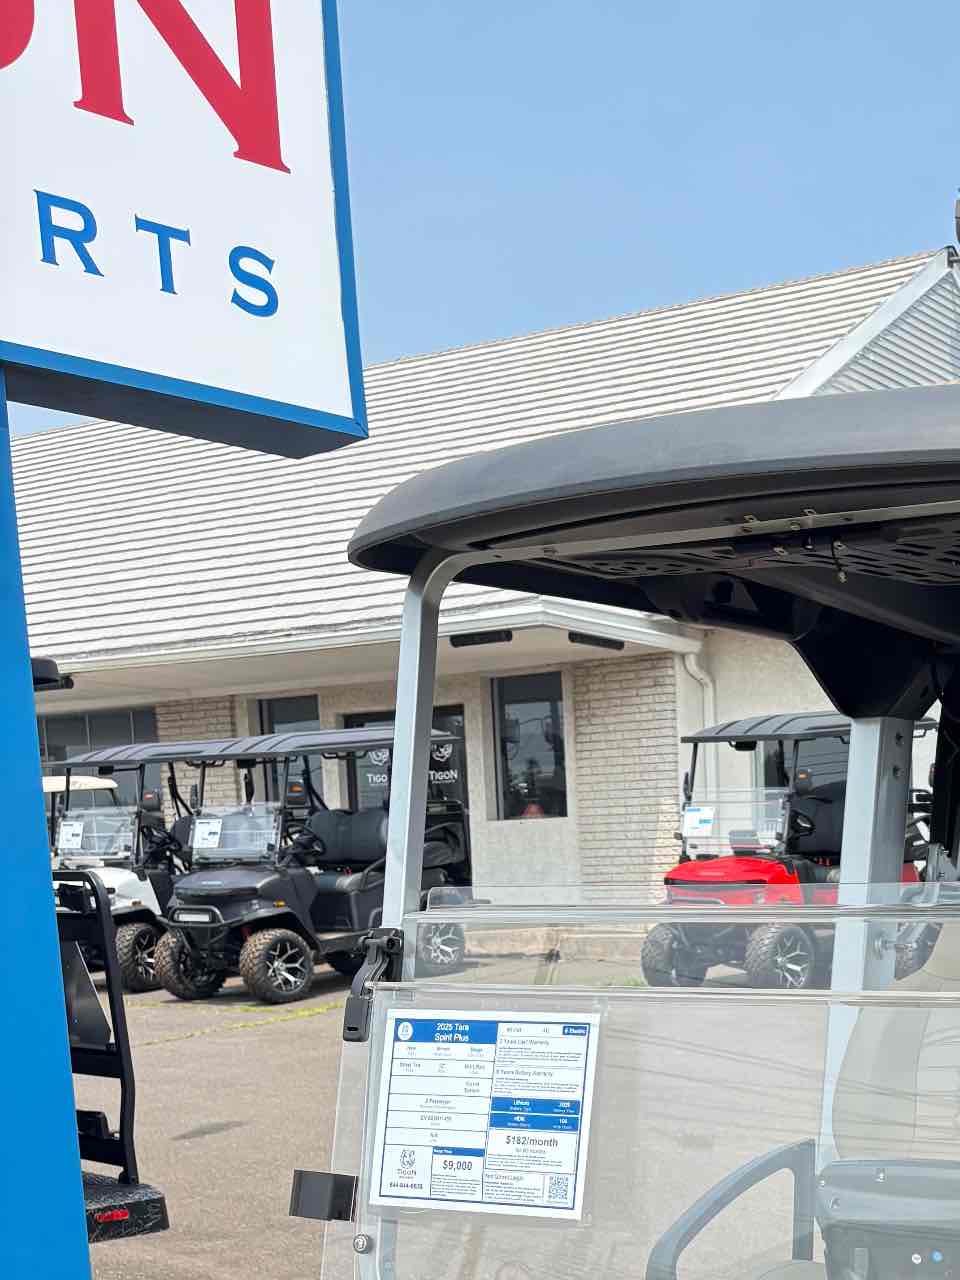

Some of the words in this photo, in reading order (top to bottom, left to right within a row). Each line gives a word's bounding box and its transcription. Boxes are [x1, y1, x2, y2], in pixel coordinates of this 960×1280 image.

[429, 770, 458, 780] TIGON
[436, 1022, 453, 1031] 2025
[455, 1023, 470, 1031] Tara
[443, 1160, 473, 1171] $9,000
